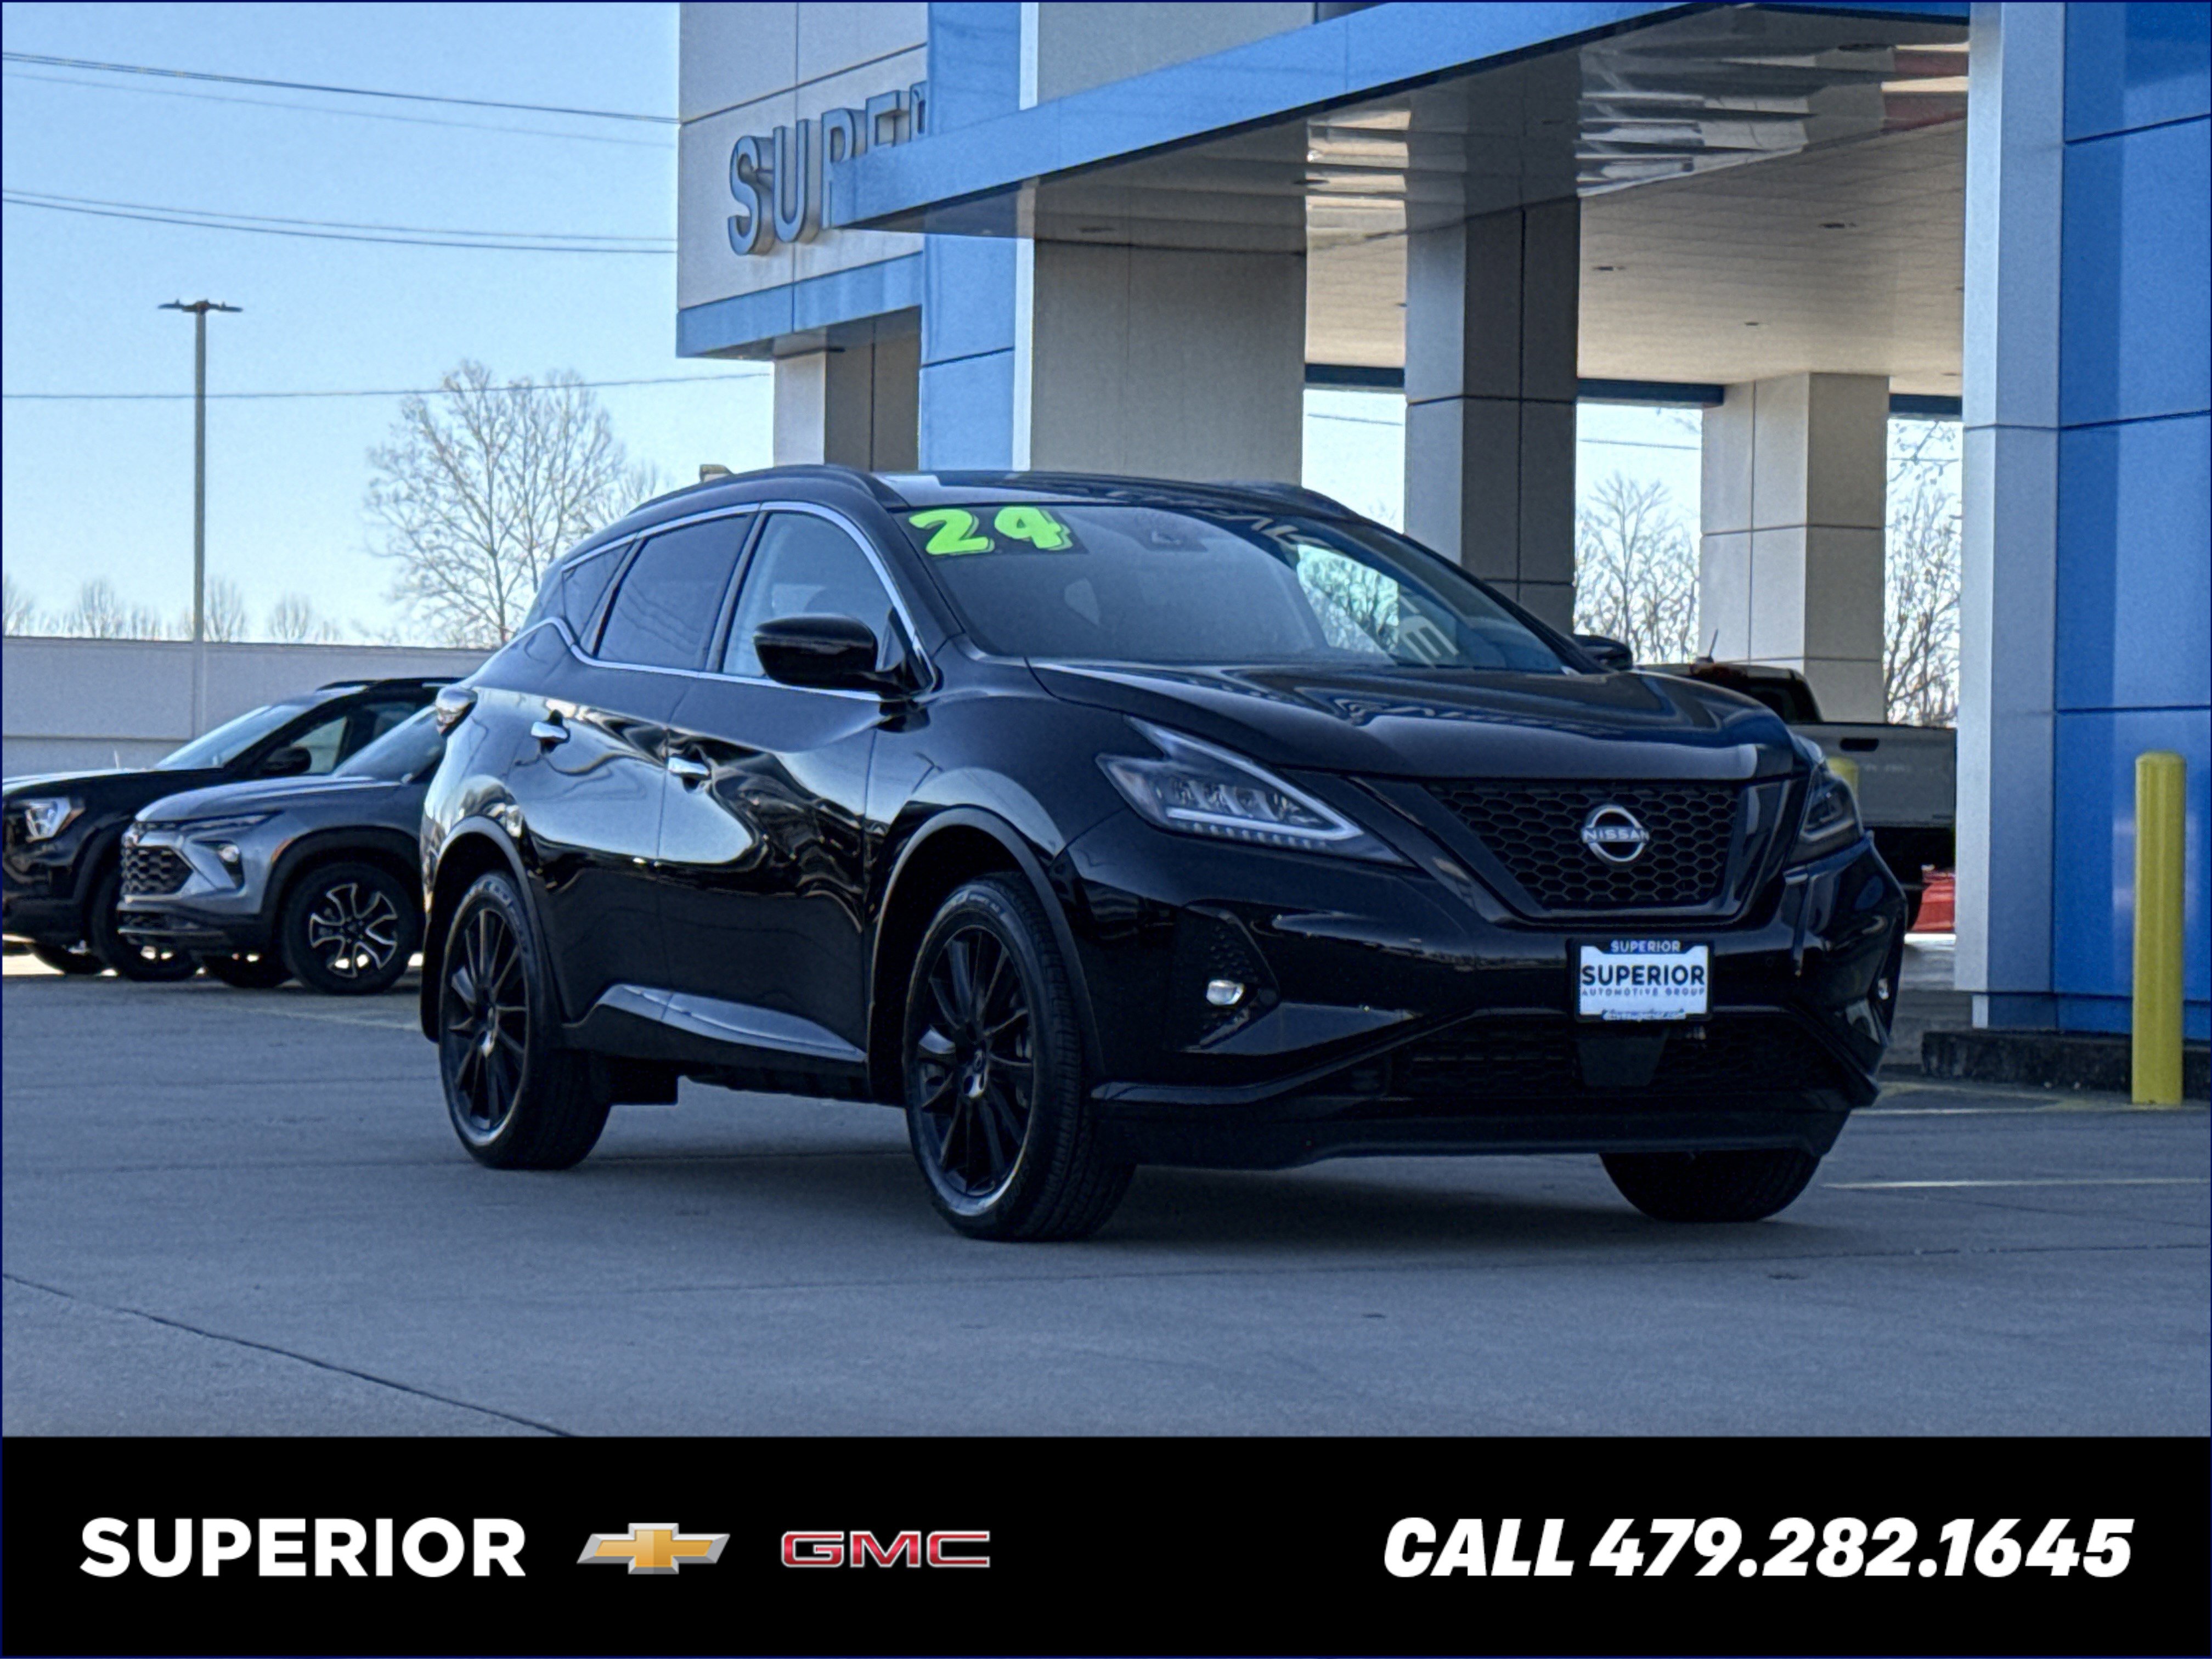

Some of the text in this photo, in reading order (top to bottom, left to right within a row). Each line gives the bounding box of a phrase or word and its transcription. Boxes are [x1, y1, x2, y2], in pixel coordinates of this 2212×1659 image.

[909, 505, 1074, 556] 24
[1582, 828, 1650, 842] NISSAN
[1610, 940, 1681, 952] SUPERIOR
[1582, 964, 1705, 986] SUPERIOR
[1582, 987, 1705, 996] AUTOMOTIVE GROUP
